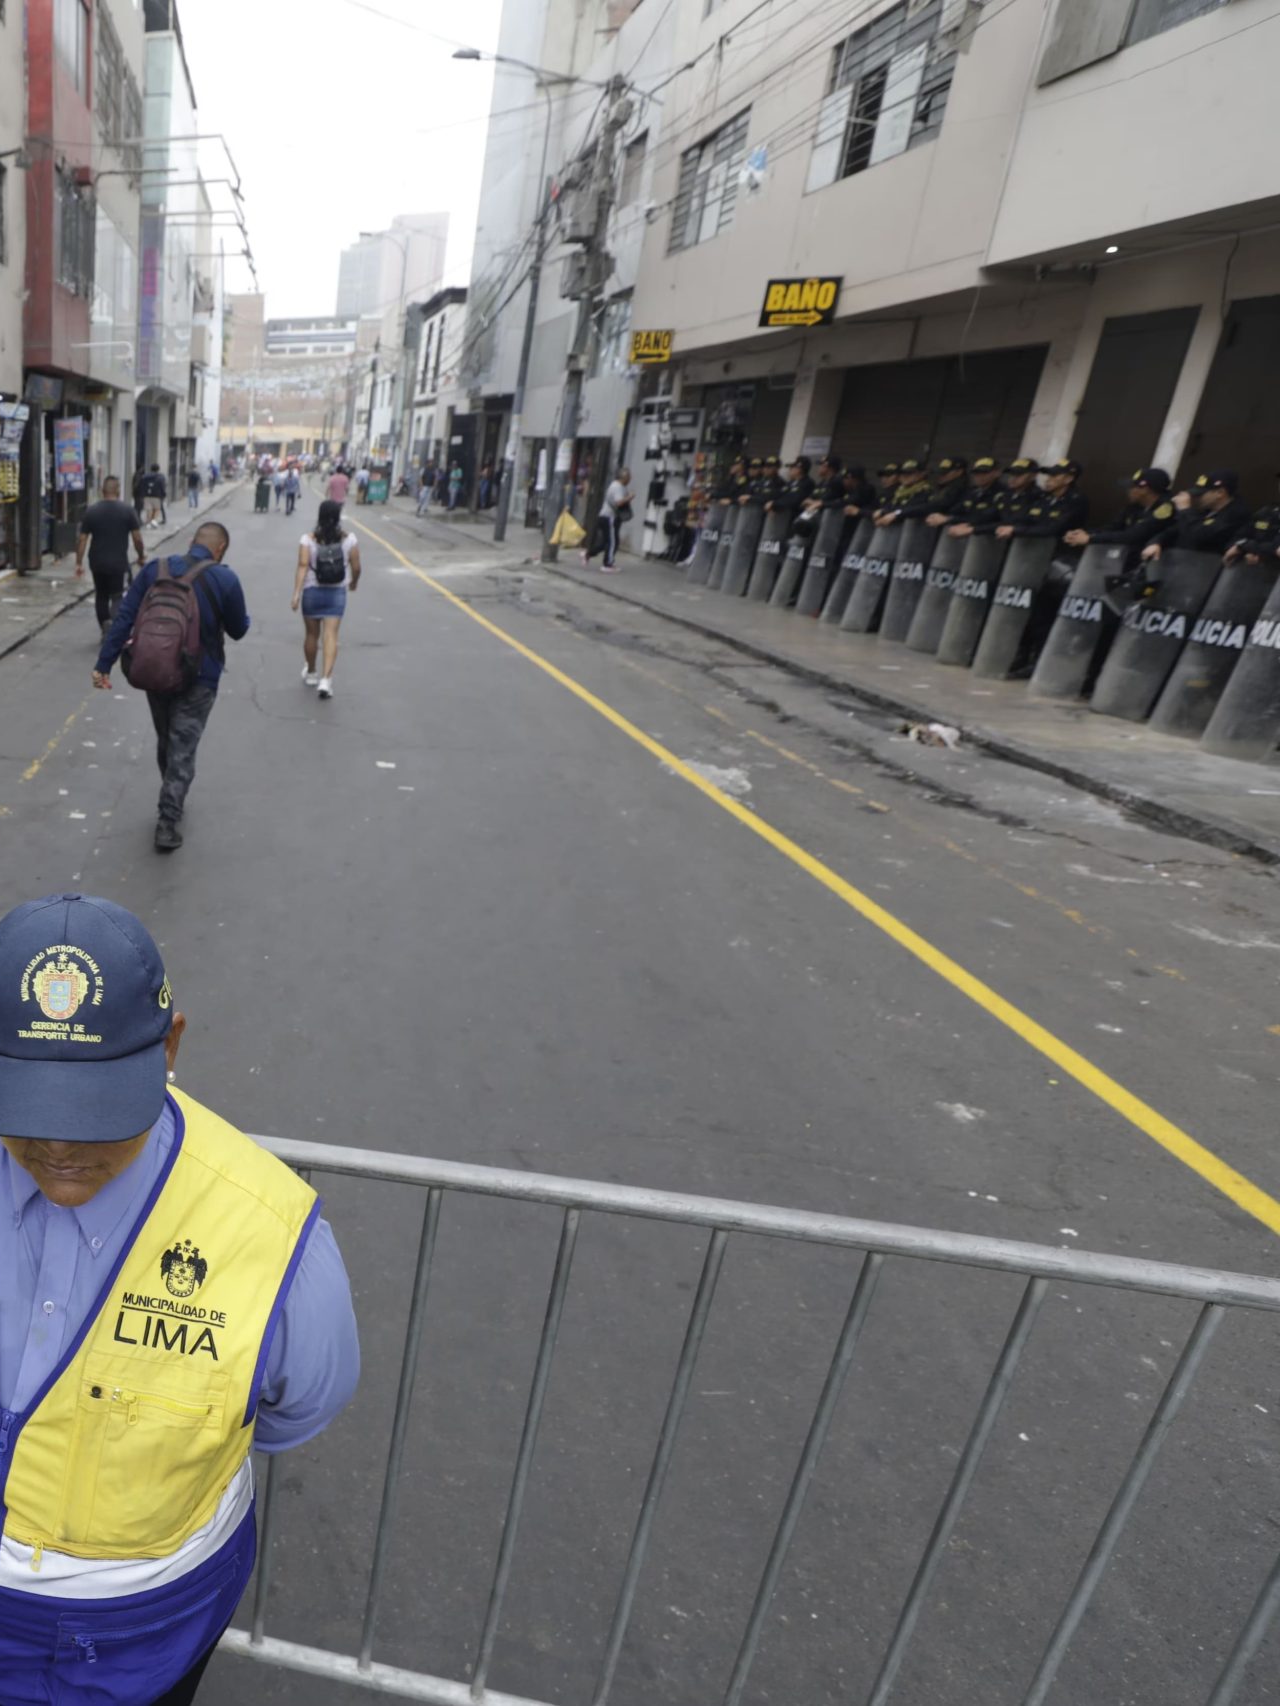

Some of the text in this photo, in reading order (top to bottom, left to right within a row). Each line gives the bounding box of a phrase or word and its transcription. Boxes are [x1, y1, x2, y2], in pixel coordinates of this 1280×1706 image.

[765, 279, 837, 312] BAÑO
[45, 944, 100, 974] METROPOLITANA
[21, 951, 46, 1002] MUNICIPALIDAD
[94, 976, 104, 987] DE
[91, 988, 104, 1006] LIMA
[17, 1030, 102, 1043] TRANSPORTE URBANO
[31, 1021, 85, 1032] GERENCIA DE
[122, 1292, 227, 1324] MUNICIPALIDAD DE
[114, 1311, 218, 1361] LIMA
